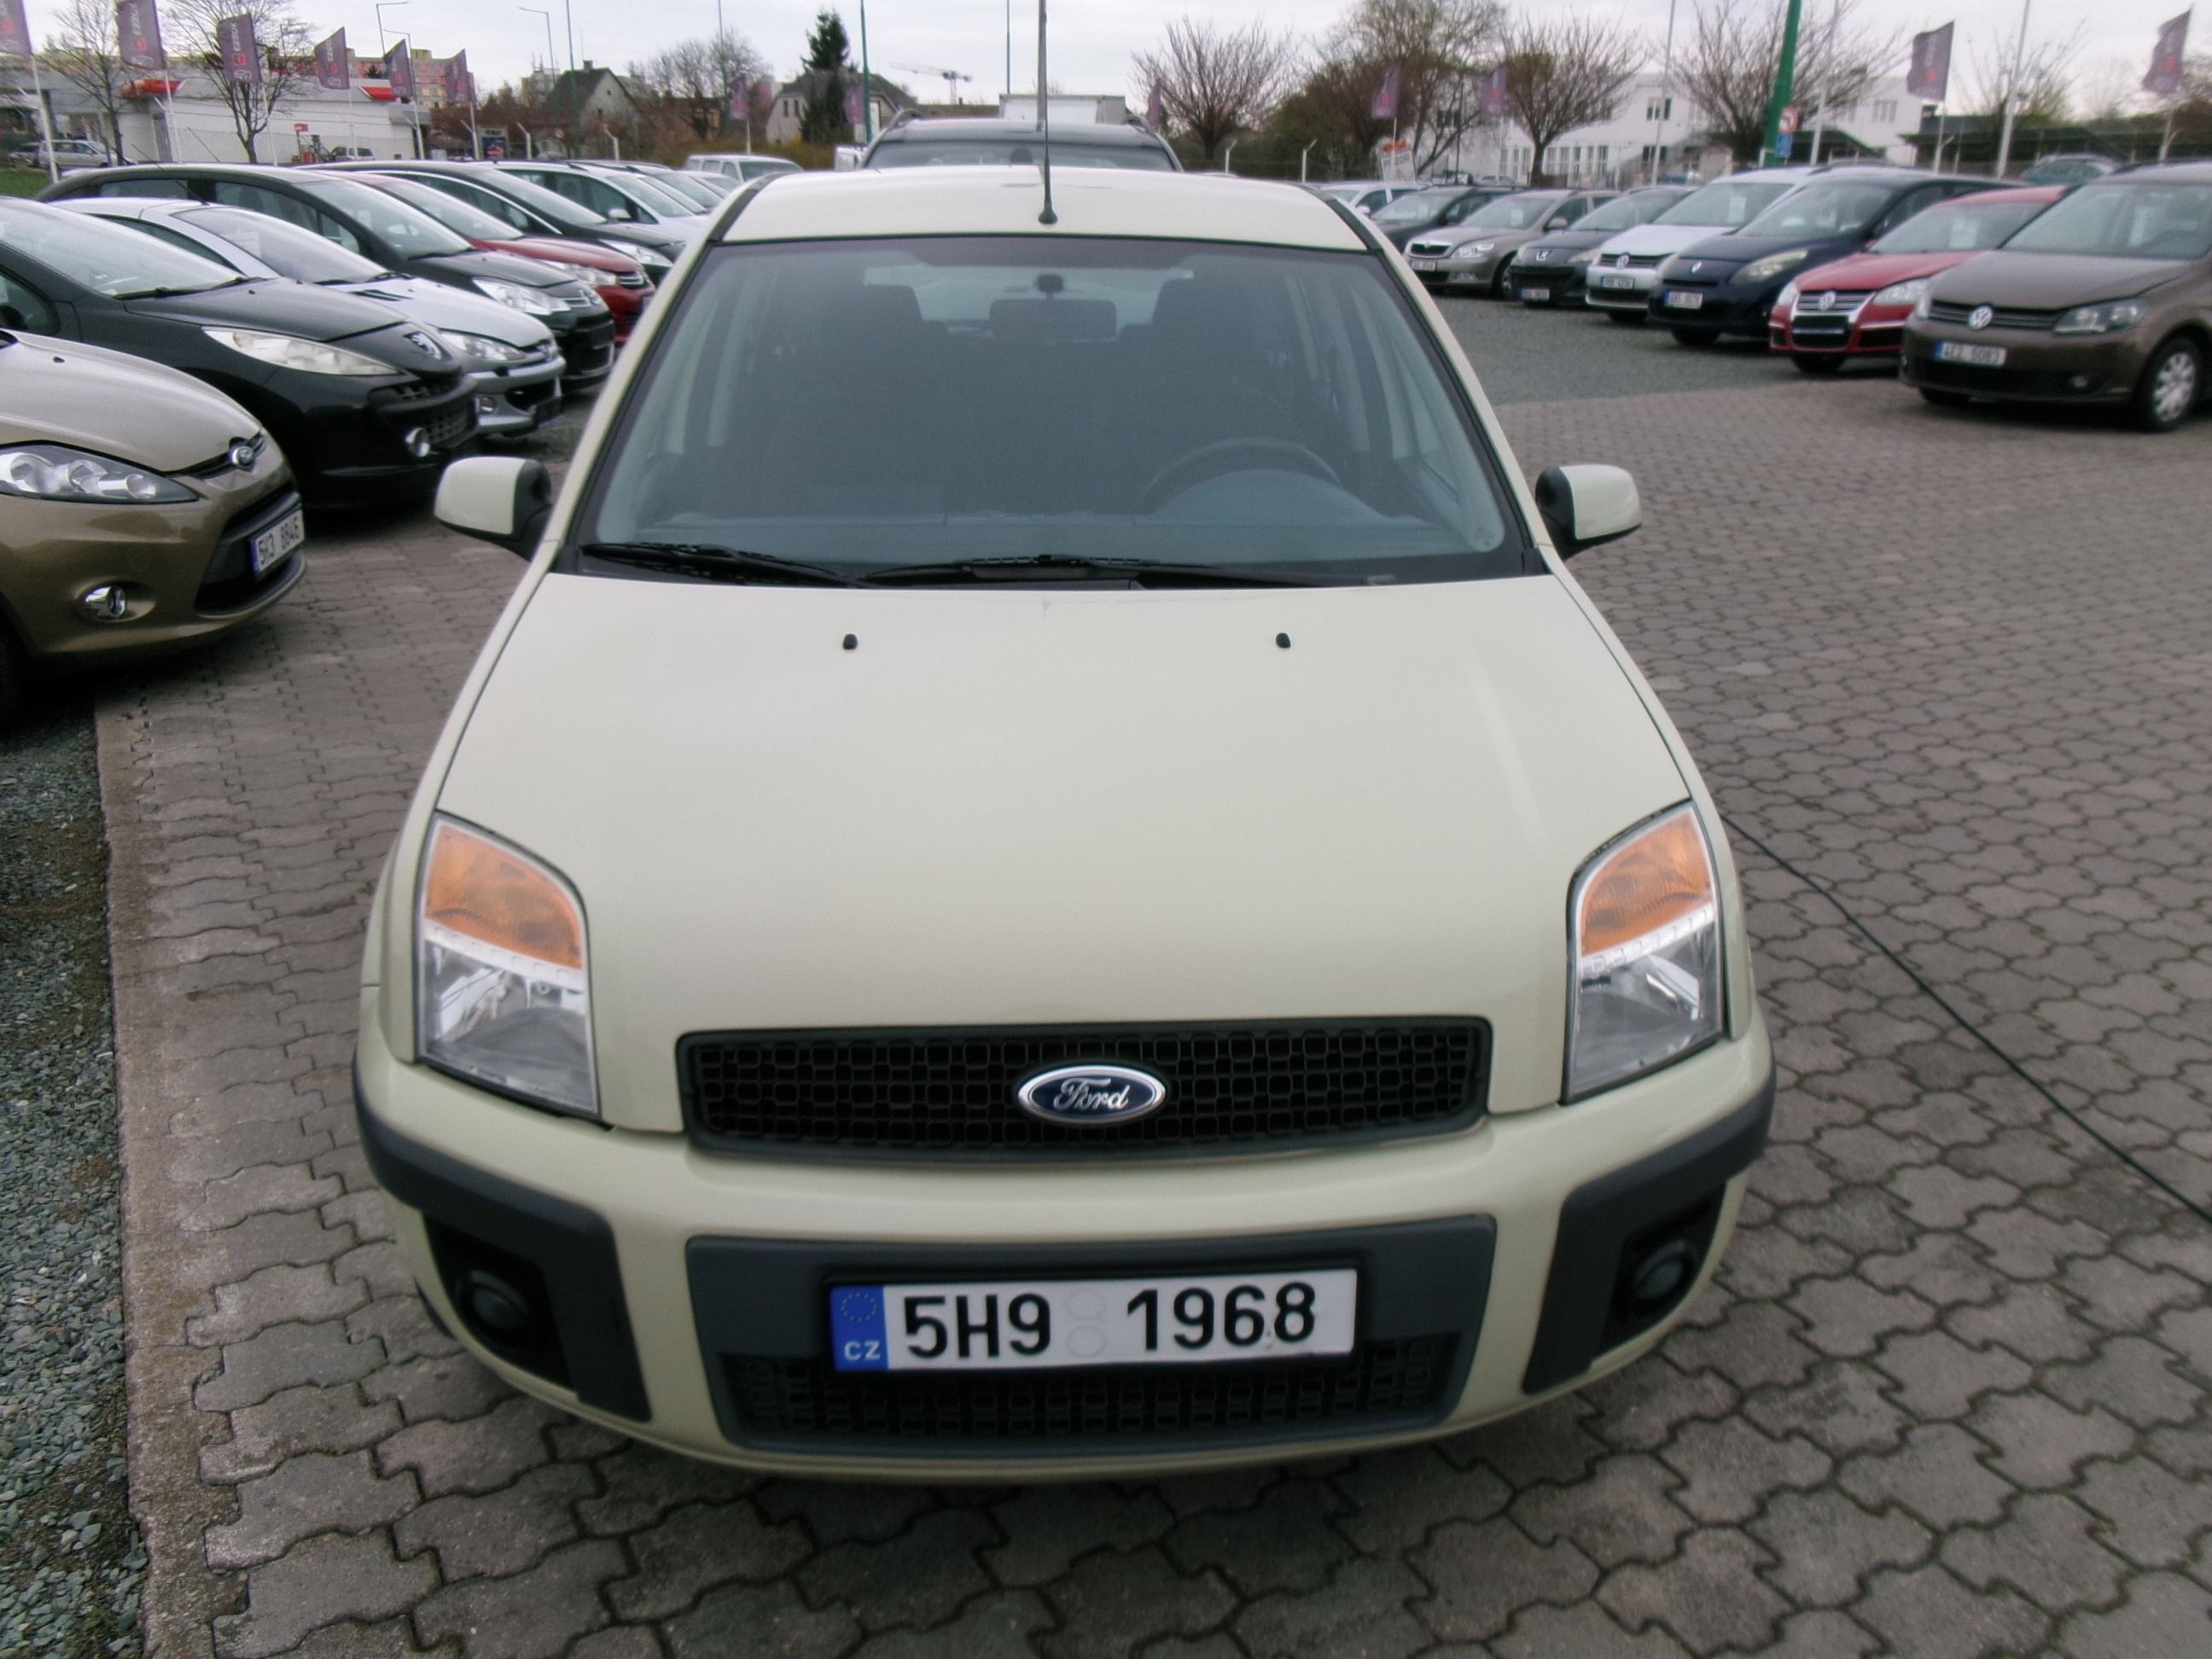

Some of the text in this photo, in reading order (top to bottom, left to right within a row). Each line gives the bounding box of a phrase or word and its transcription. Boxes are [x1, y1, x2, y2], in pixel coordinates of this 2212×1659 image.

[1053, 1077, 1131, 1109] Ford
[902, 1282, 1317, 1359] 5H9 1968
[844, 1341, 881, 1361] CZ
